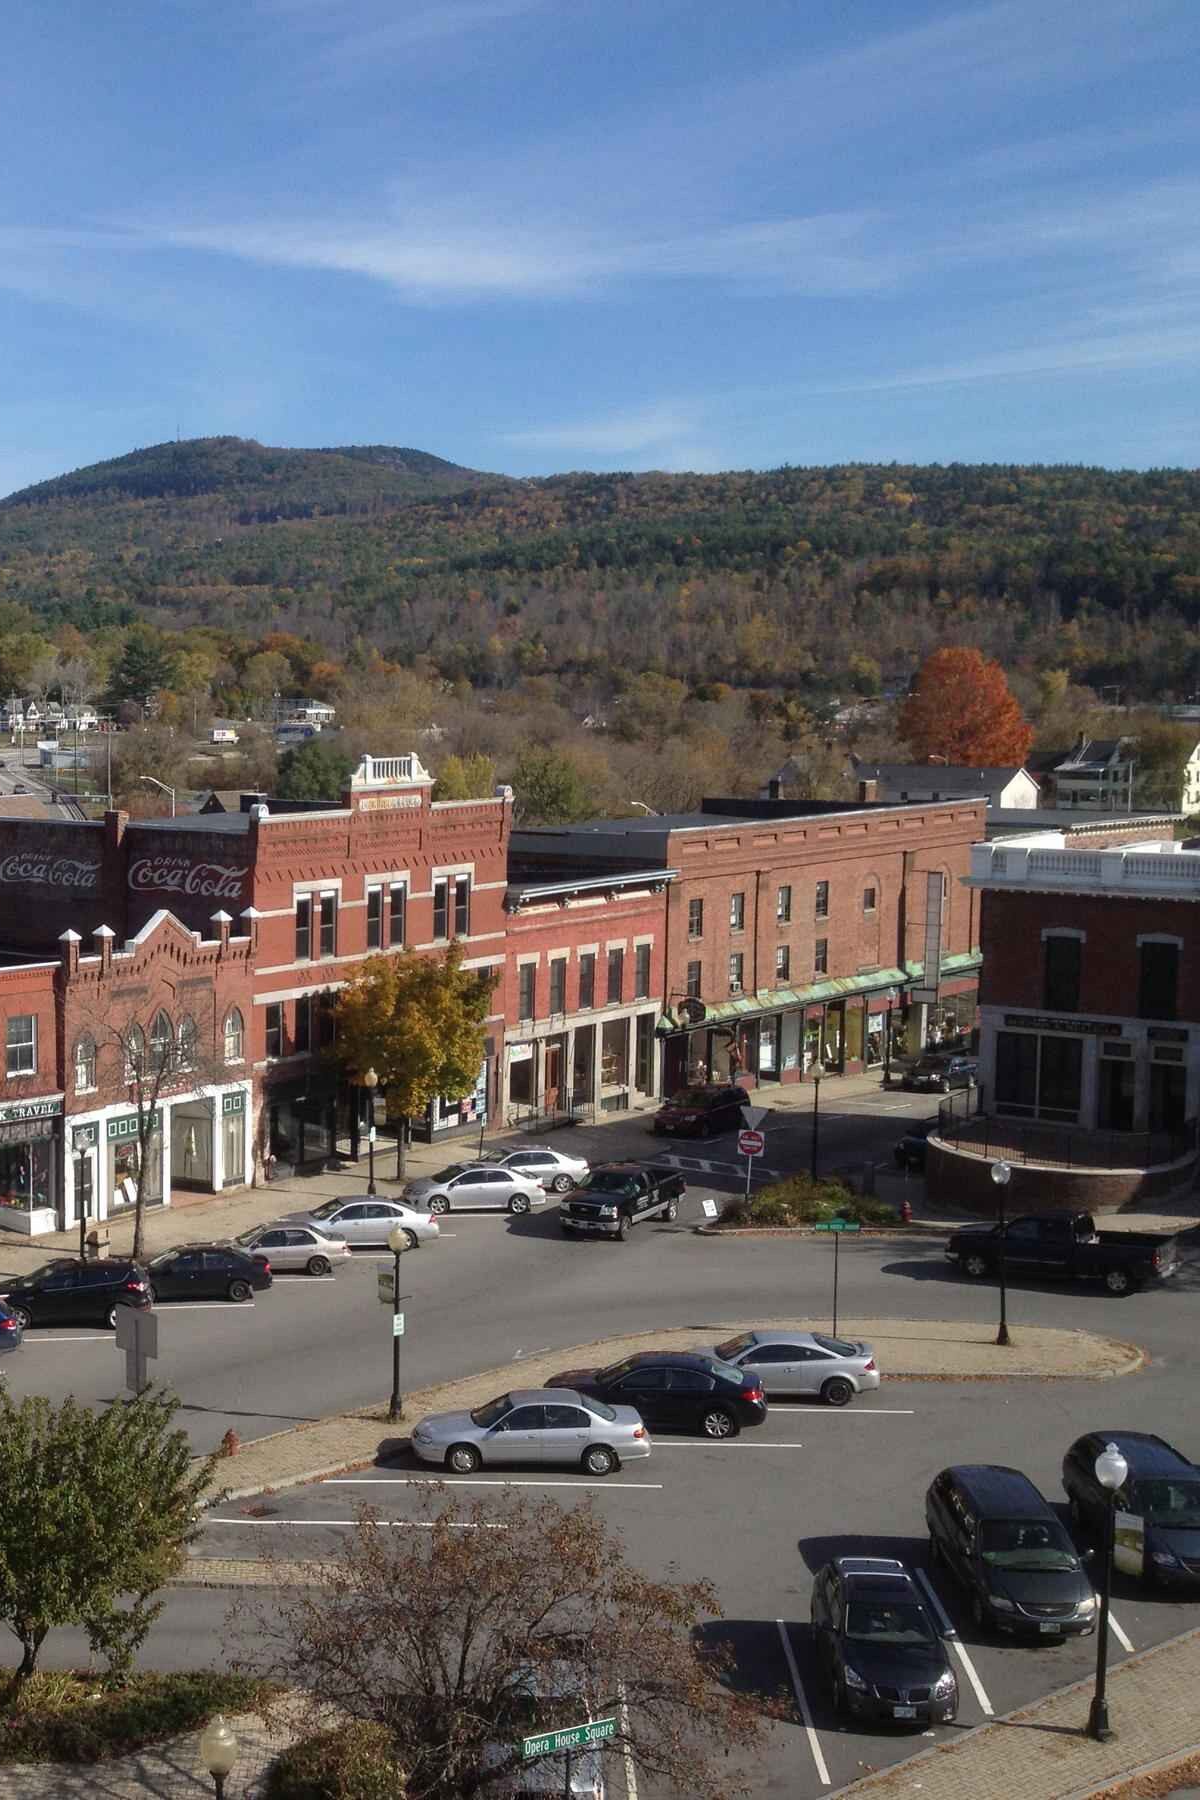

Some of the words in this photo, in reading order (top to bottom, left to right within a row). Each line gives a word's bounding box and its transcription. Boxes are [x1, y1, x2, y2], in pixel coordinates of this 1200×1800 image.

[13, 1104, 54, 1118] TRAVEL
[525, 1739, 550, 1756] Opera
[555, 1731, 580, 1748] House
[585, 1723, 614, 1744] Square
